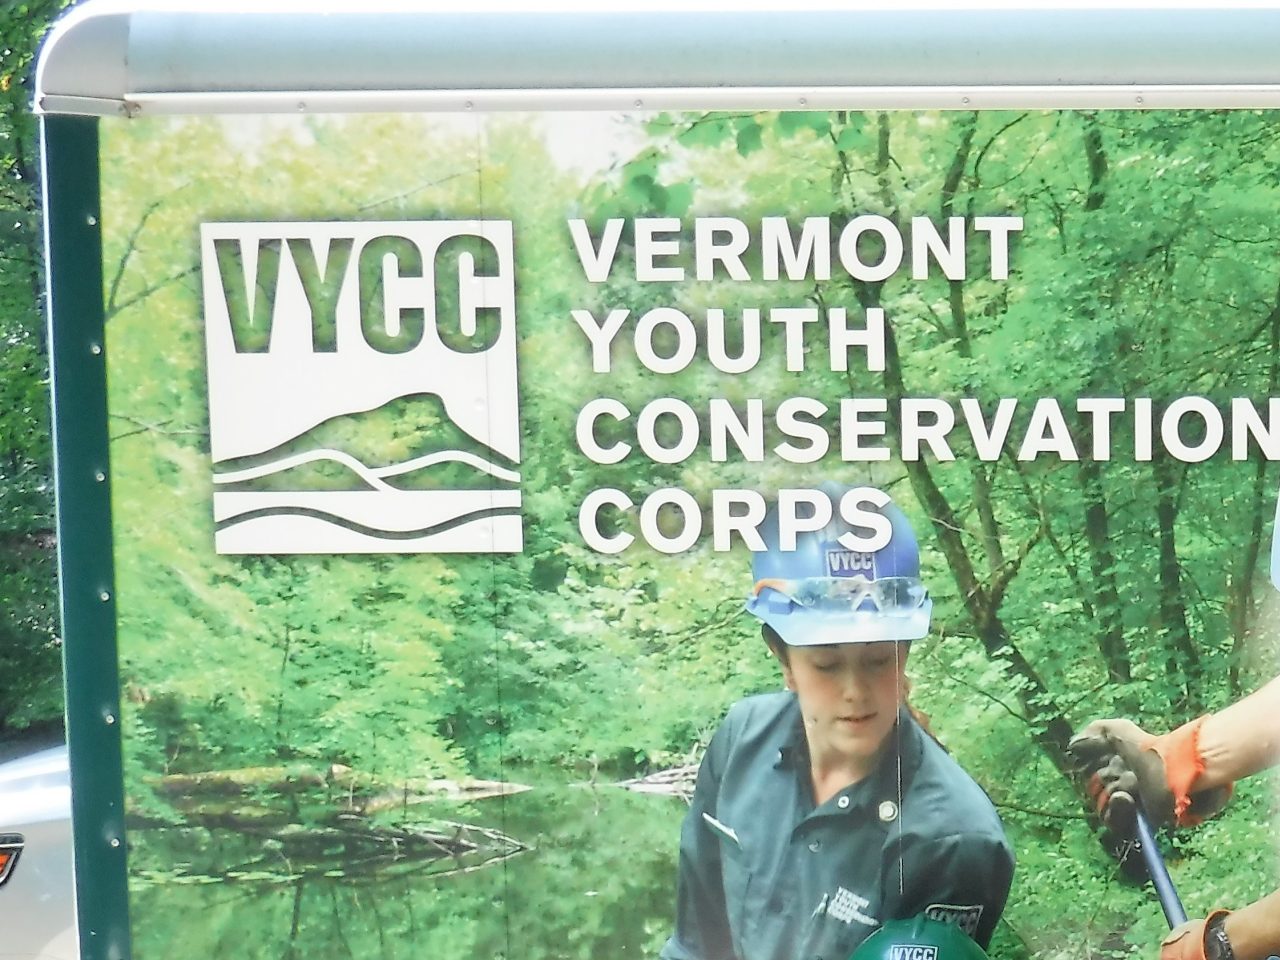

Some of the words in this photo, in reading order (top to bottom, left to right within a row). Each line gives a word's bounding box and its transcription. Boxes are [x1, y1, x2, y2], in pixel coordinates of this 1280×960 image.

[567, 215, 1024, 283] VERMONT
[214, 235, 503, 354] VYCC
[571, 306, 886, 374] YOUTH
[578, 487, 893, 554] CORPS
[829, 552, 872, 572] VYCC
